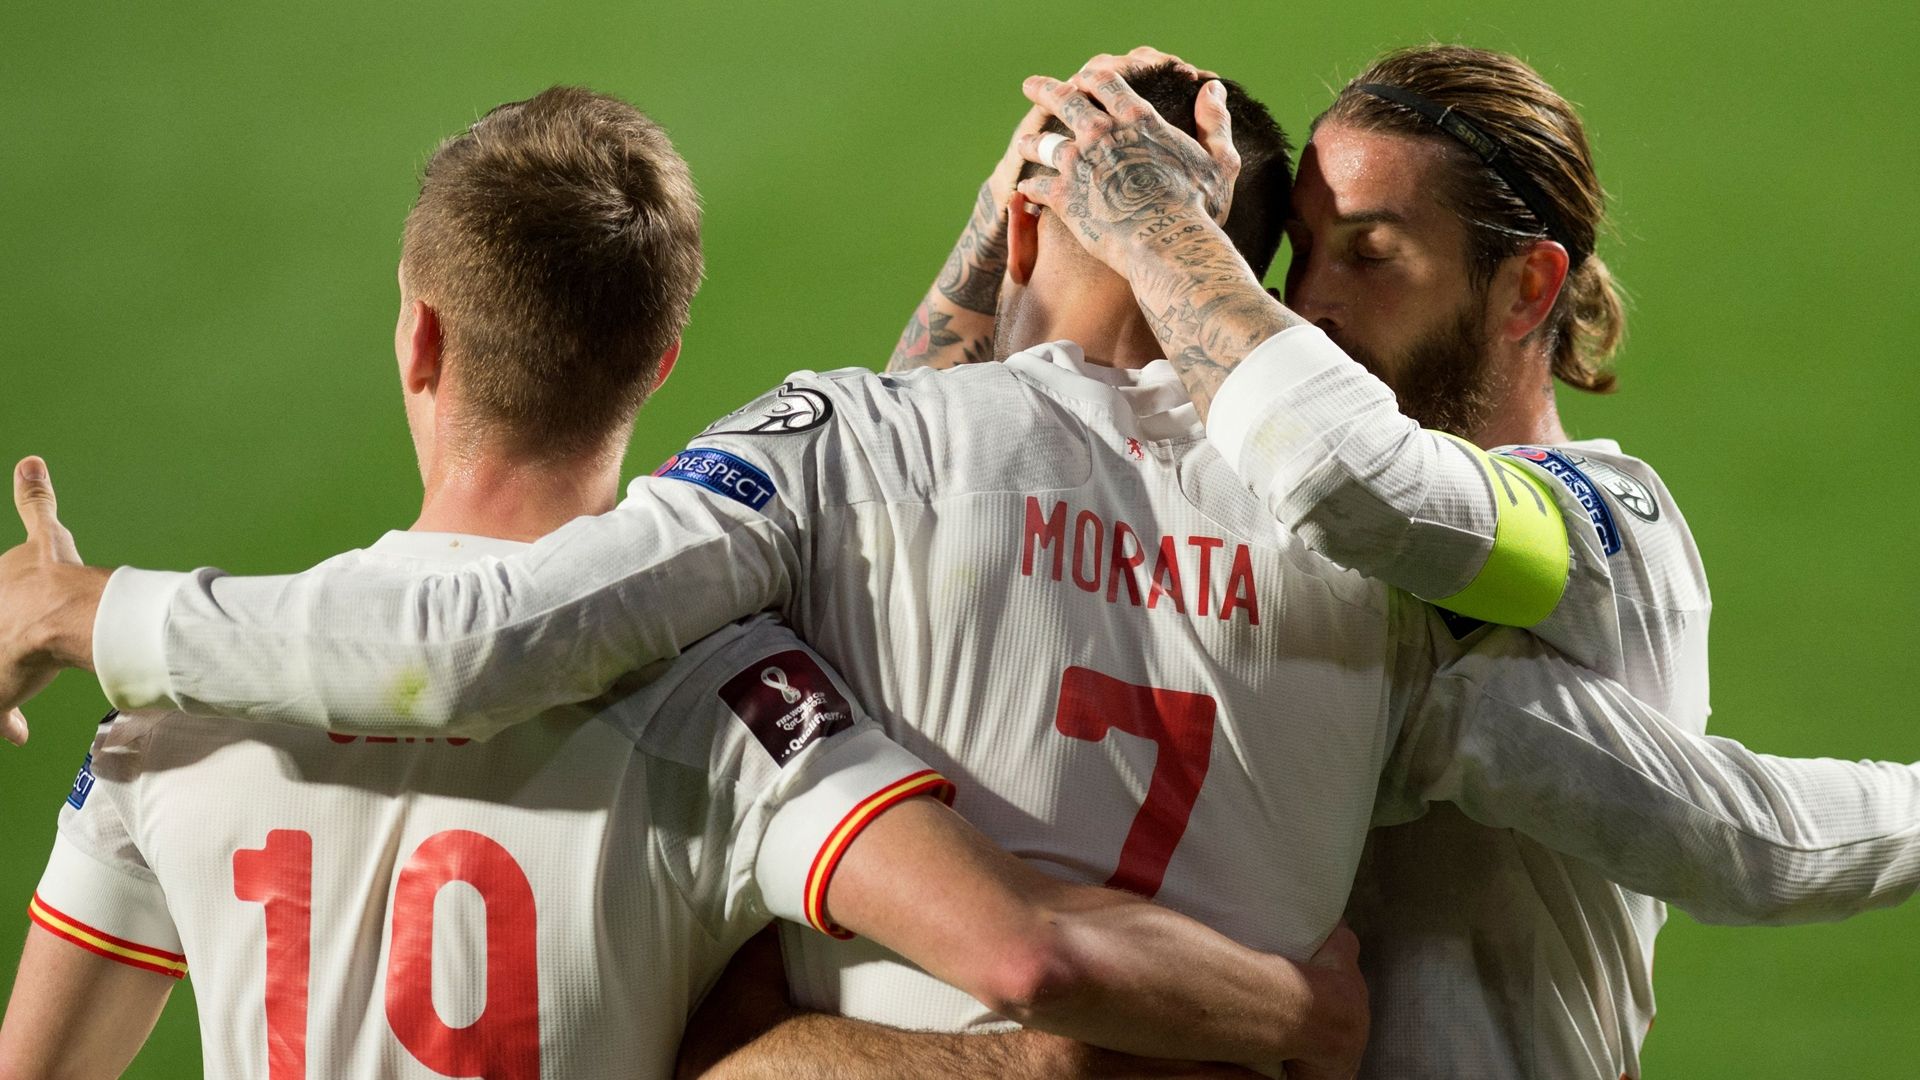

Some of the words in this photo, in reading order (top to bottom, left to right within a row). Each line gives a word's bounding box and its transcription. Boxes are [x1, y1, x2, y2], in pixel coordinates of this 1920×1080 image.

[672, 455, 770, 504] RESPECT
[1544, 460, 1611, 554] RESPECT
[1022, 496, 1260, 626] MORATA
[775, 713, 792, 729] FIFA
[790, 695, 813, 717] WORLD
[1055, 665, 1217, 898] 7
[232, 828, 541, 1080] 19
